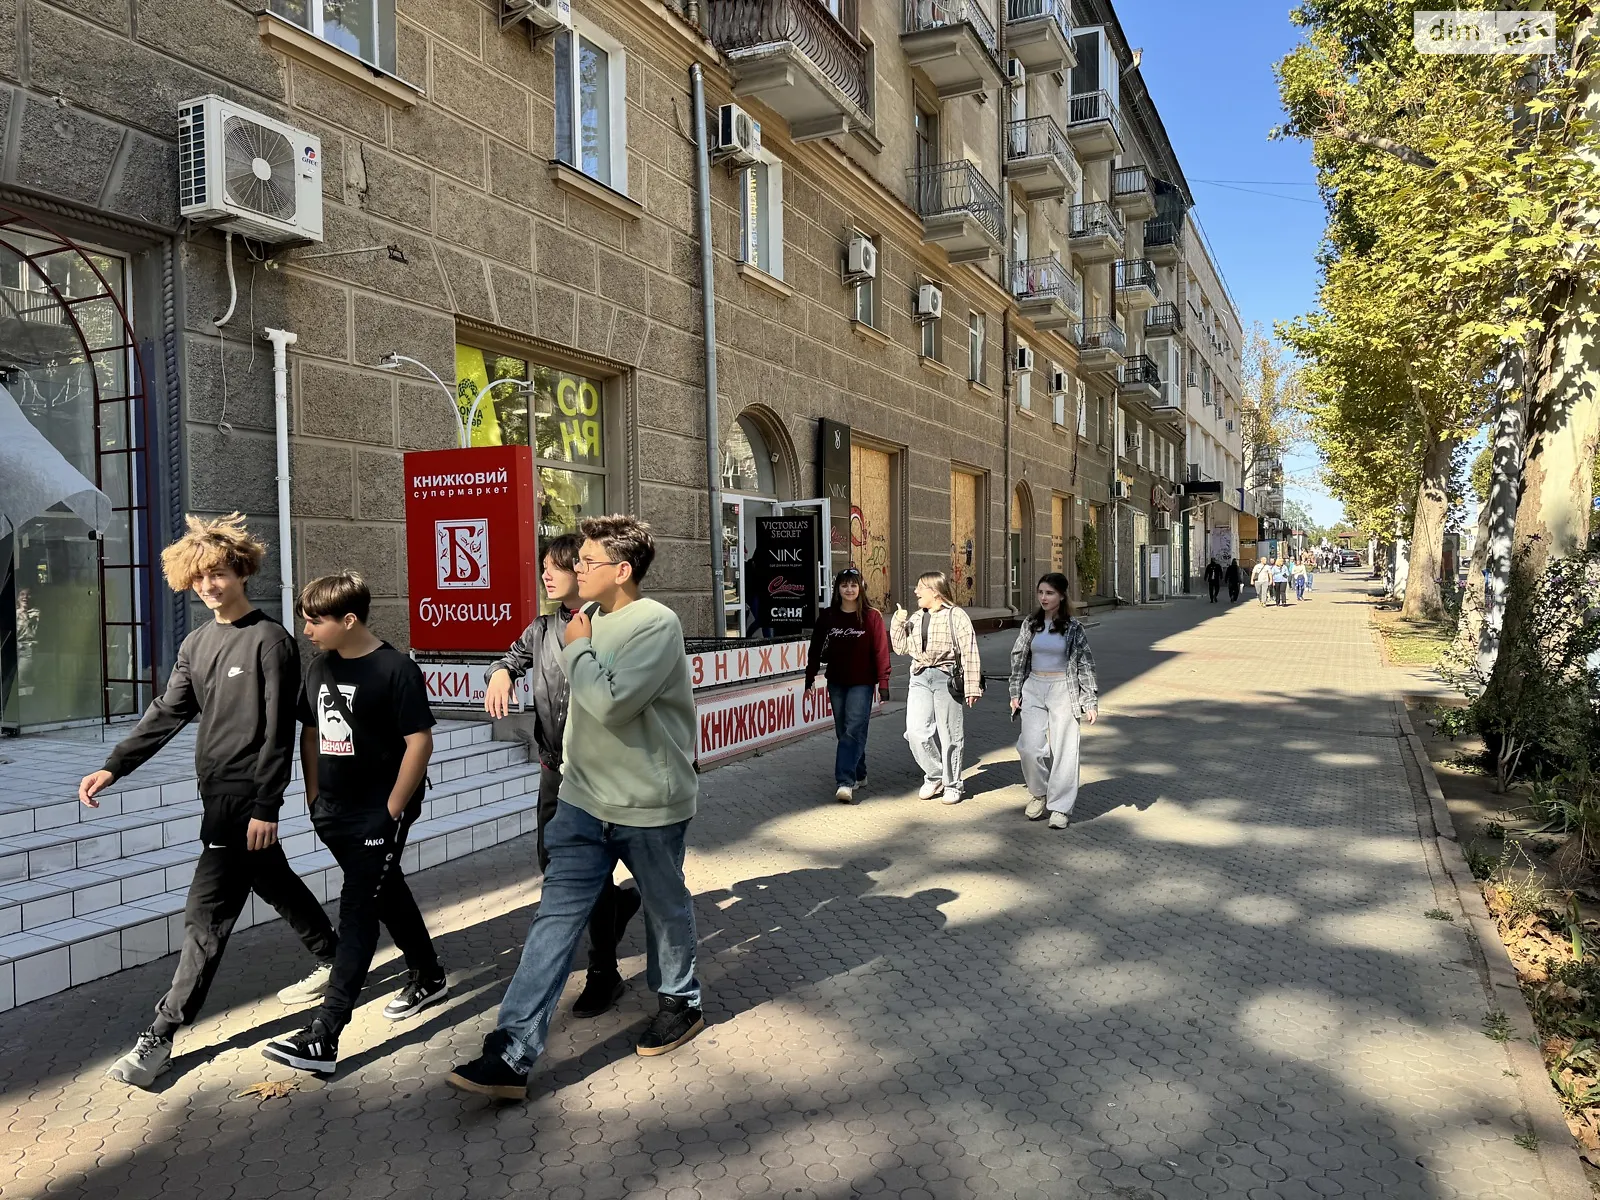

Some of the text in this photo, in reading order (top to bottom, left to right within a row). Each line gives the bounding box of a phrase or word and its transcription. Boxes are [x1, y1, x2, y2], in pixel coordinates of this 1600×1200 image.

[413, 486, 508, 499] супермаркет
[762, 521, 808, 530] VICTORIA'S
[771, 530, 801, 538] SECRET
[419, 597, 512, 627] буквиця
[692, 643, 806, 685] ЗНИЖКИ
[701, 688, 795, 753] КНИЖКОВИЙ
[322, 740, 351, 752] BEHAVE
[364, 838, 385, 847] JAKO
